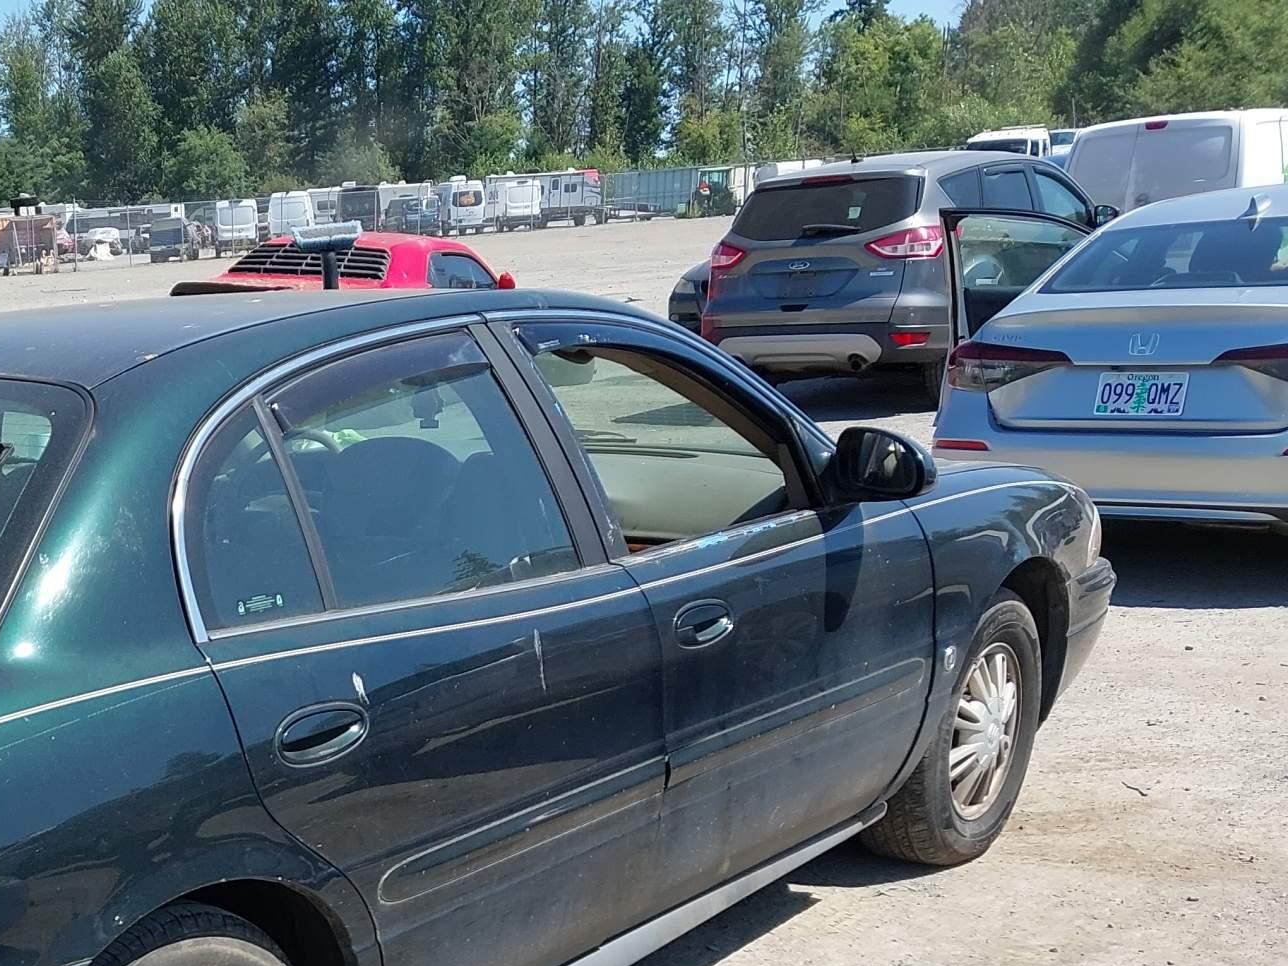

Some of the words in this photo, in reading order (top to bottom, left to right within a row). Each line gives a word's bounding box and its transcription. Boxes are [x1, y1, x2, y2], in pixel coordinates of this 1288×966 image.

[1127, 373, 1160, 383] Oregon
[1100, 382, 1136, 404] 099
[1146, 382, 1183, 405] QMZ
